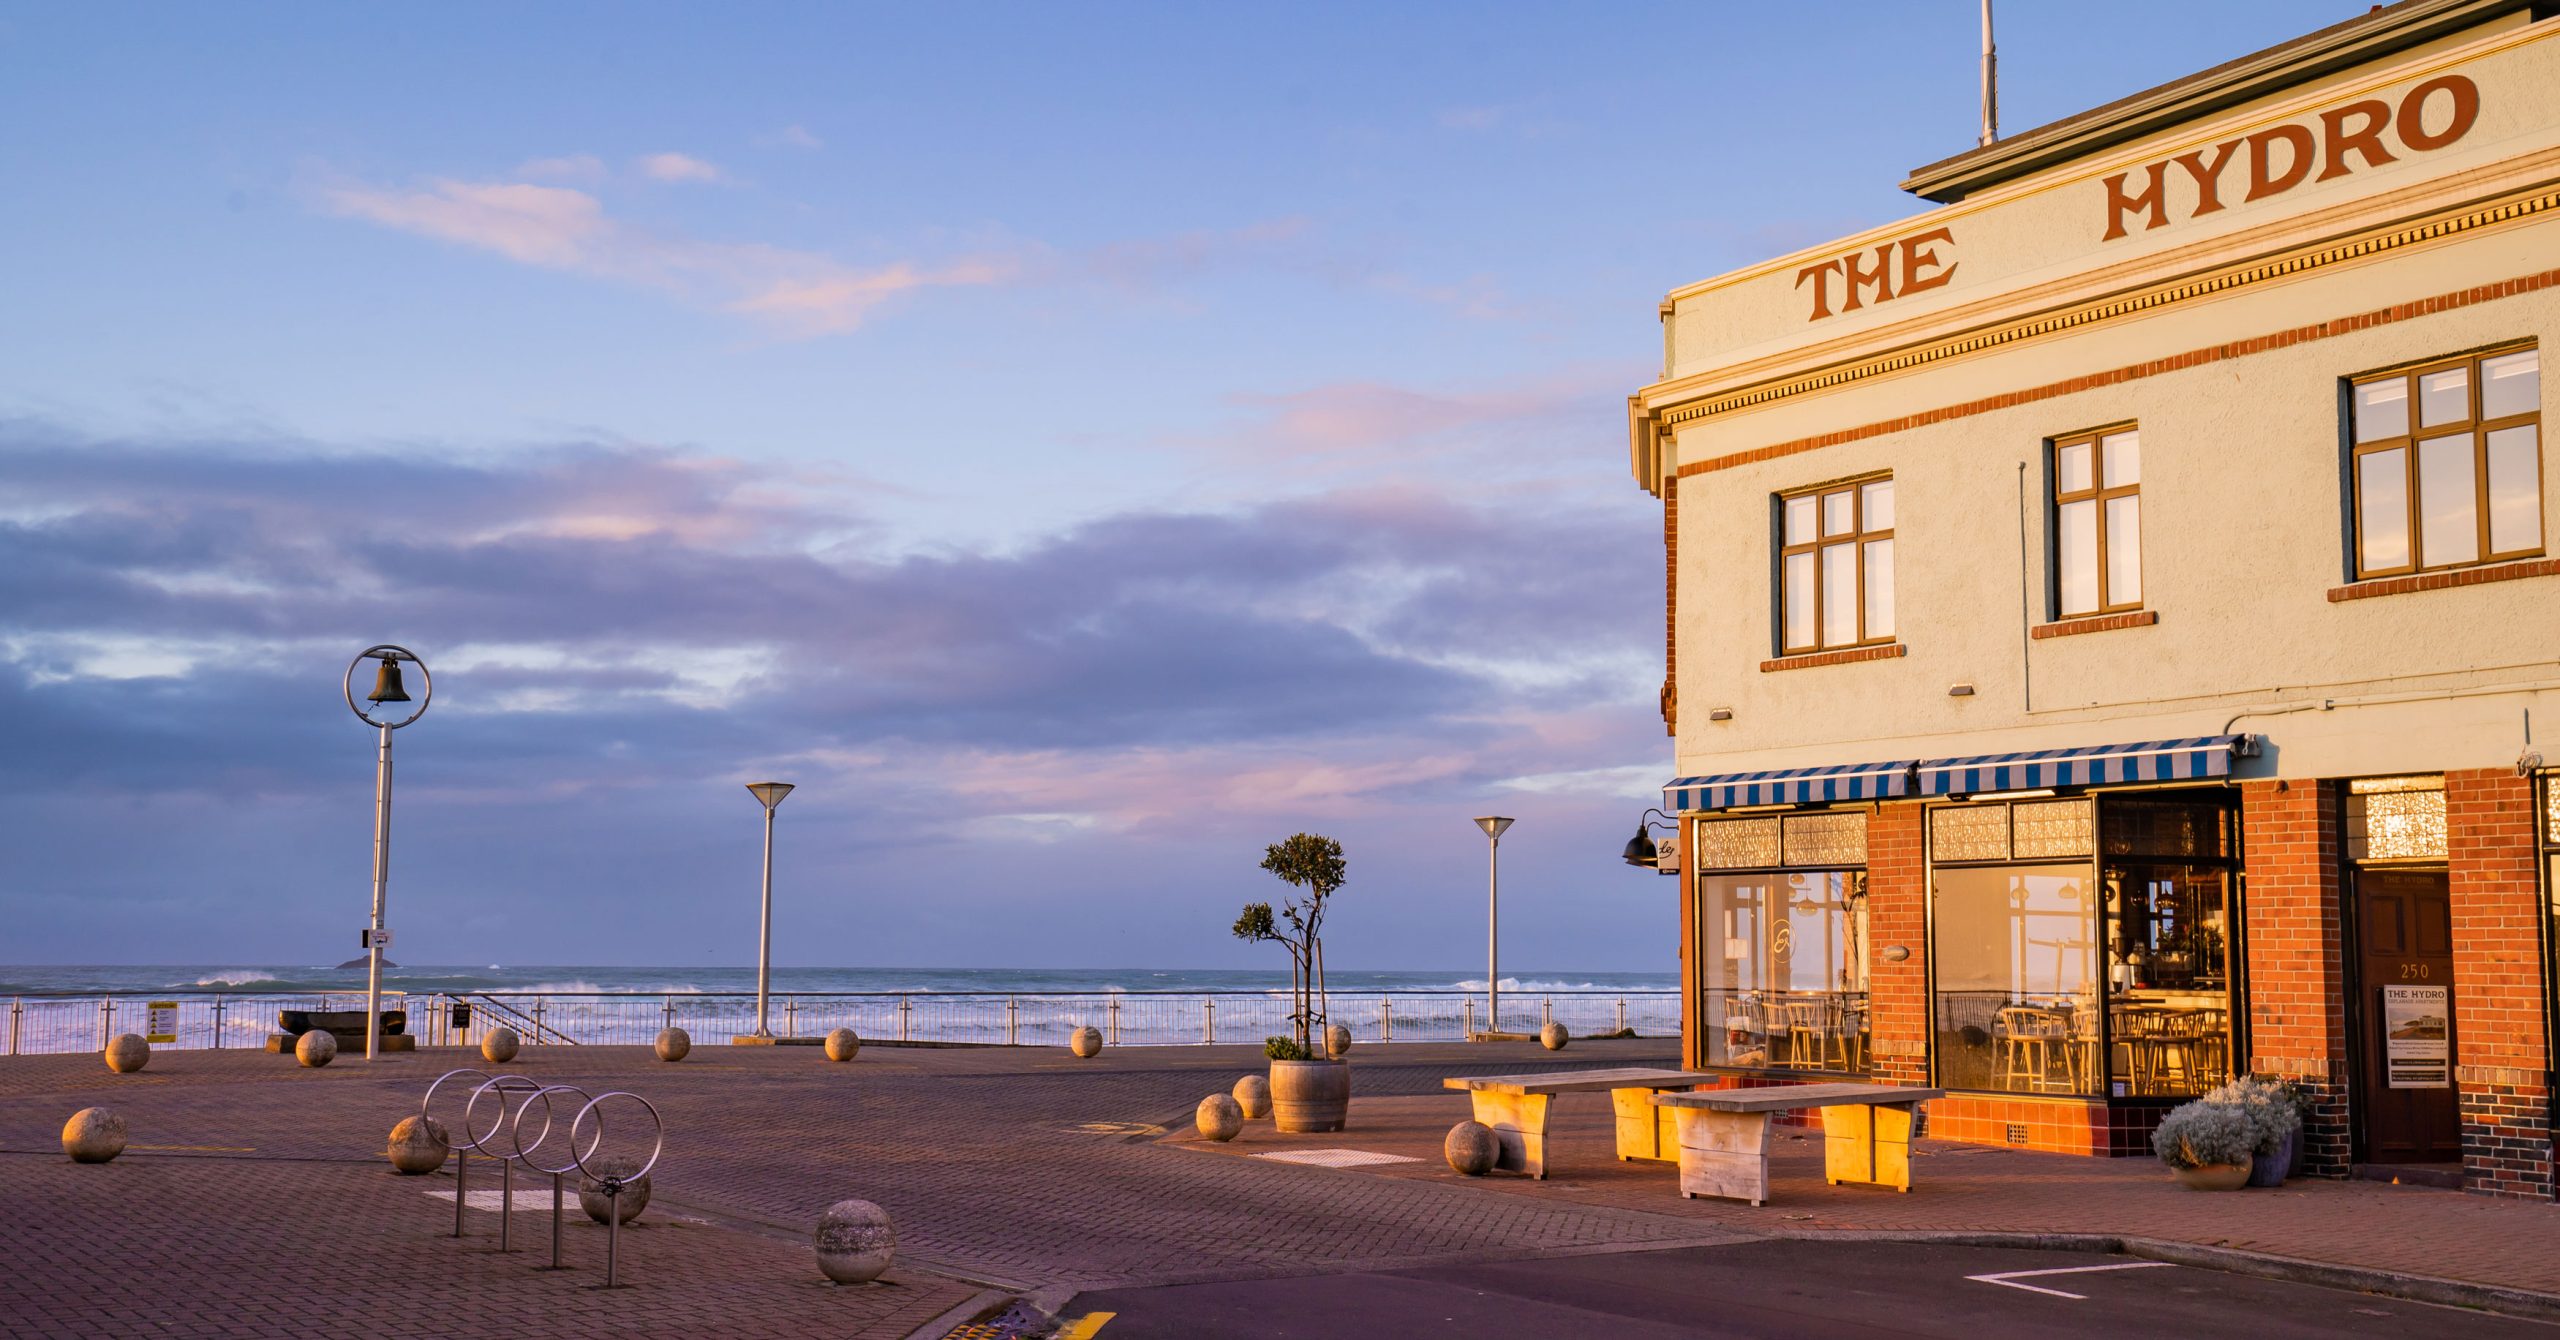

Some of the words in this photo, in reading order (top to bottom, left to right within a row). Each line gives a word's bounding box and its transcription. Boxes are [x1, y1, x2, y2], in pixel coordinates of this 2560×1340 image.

[1794, 226, 1959, 322] THE
[2101, 74, 2481, 242] HYDRO
[2383, 875, 2401, 883] THE
[2404, 876, 2435, 884] HYDRO
[2401, 964, 2429, 979] 250
[2387, 989, 2408, 998] THE
[2411, 990, 2445, 999] HYDRO
